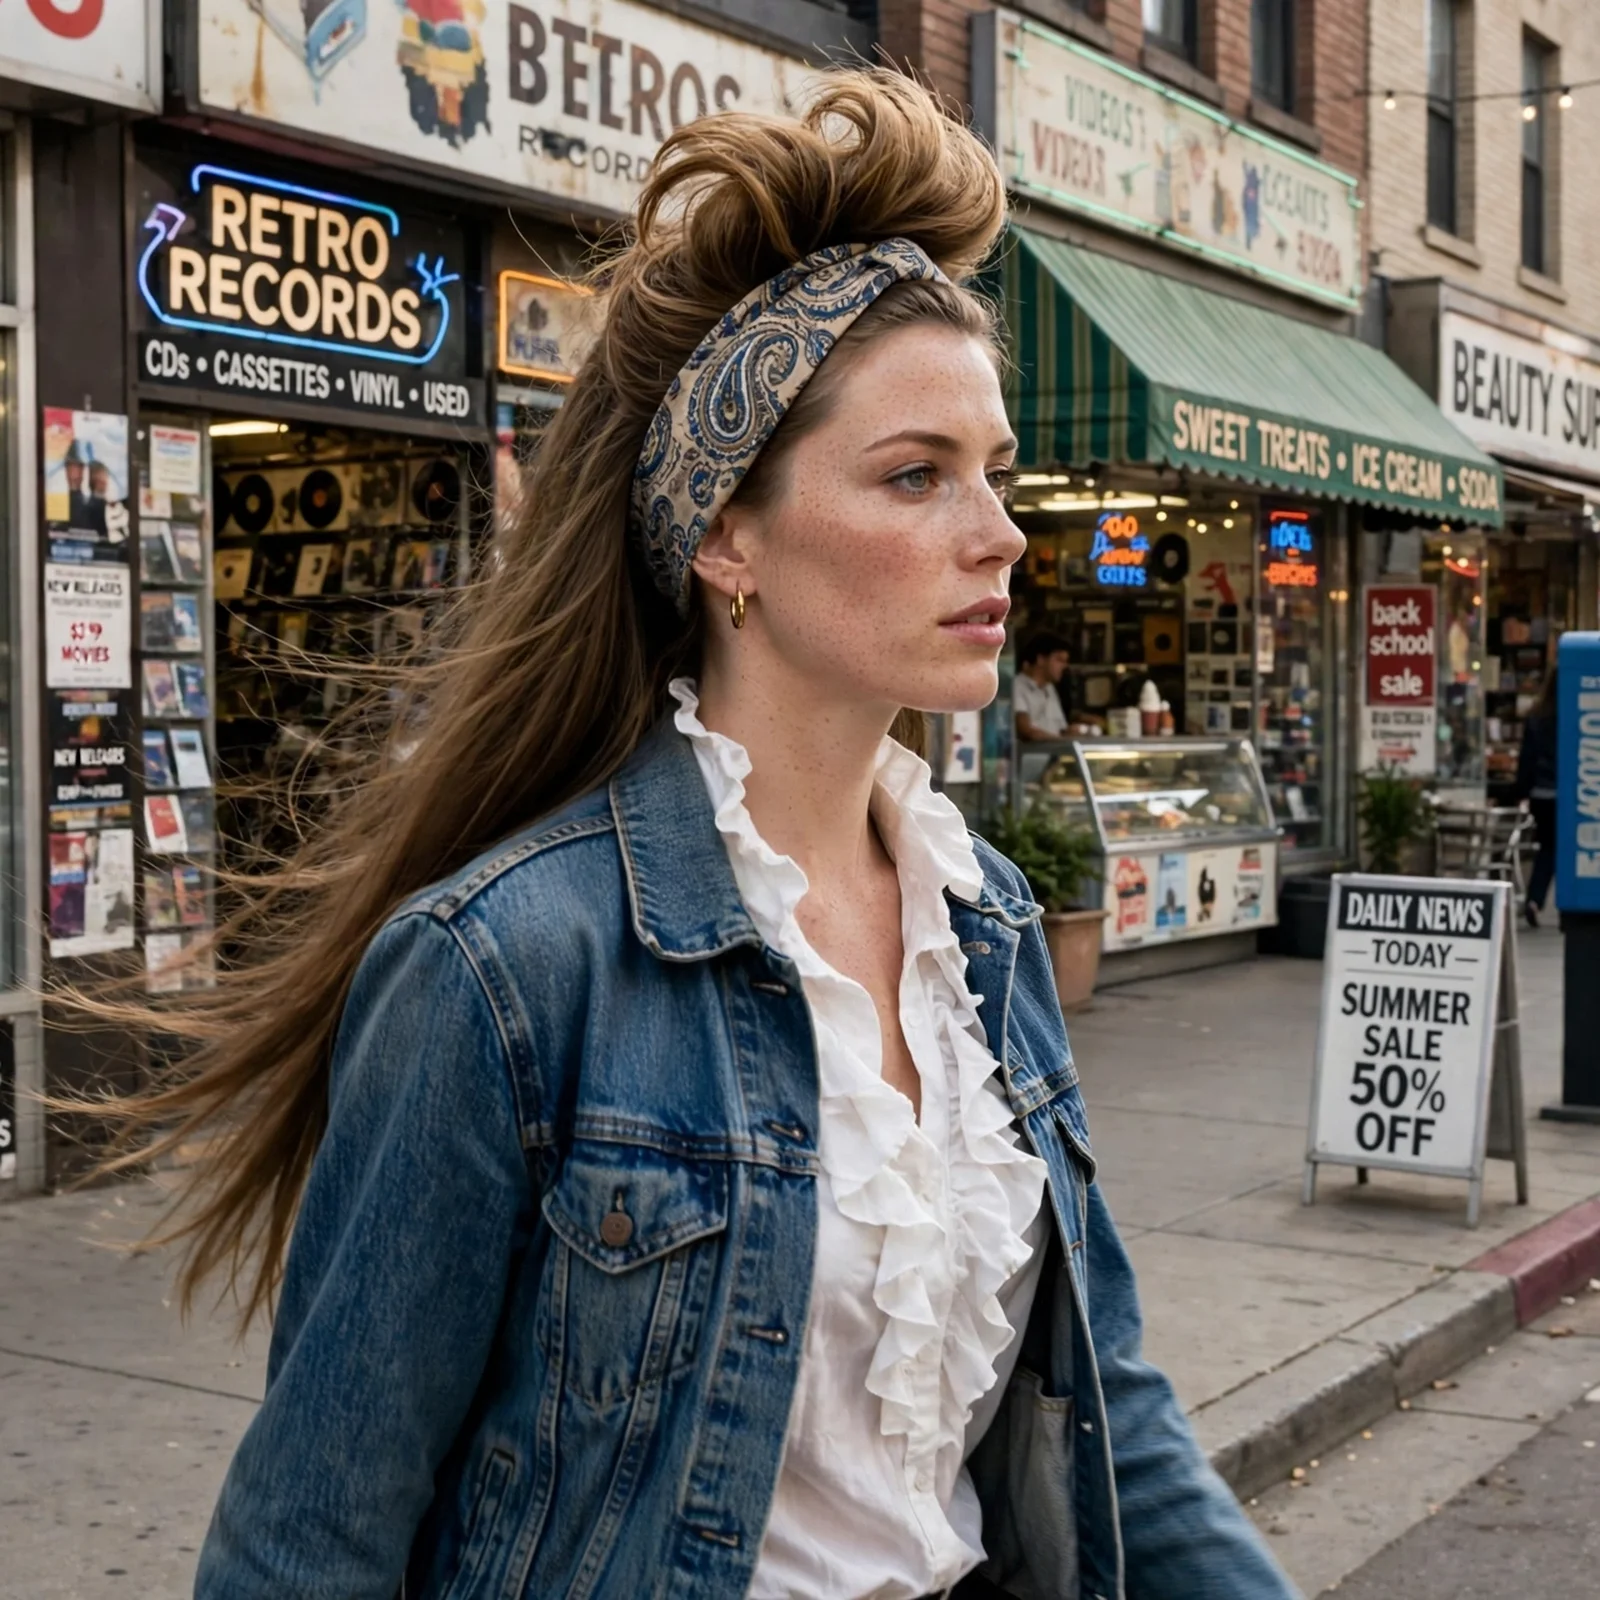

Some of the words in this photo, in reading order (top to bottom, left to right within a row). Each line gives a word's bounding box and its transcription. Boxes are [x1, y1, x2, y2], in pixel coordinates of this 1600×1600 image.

[211, 184, 390, 280] RETRO
[169, 246, 421, 350] RECORDS
[145, 339, 190, 380] CDs
[214, 349, 331, 399] CASSETTES
[350, 370, 405, 409] VINYL
[424, 382, 470, 417] USED
[1454, 339, 1554, 437] BEAUTY
[1173, 400, 1250, 462] SWEET
[1256, 419, 1331, 480] TREATS
[1352, 442, 1381, 490] ICE
[1385, 450, 1443, 501] CREAM
[1458, 466, 1500, 512] SODA
[1371, 598, 1422, 627] back
[1369, 627, 1435, 656] school
[1379, 667, 1424, 697] sale
[1346, 892, 1413, 930] DAILY
[1417, 897, 1484, 934] NEWS
[1372, 939, 1453, 969] TODAY
[1341, 982, 1471, 1026] SUMMER
[1363, 1024, 1443, 1062] SALE
[1350, 1061, 1446, 1114] 50%
[1356, 1111, 1436, 1157] OFF
